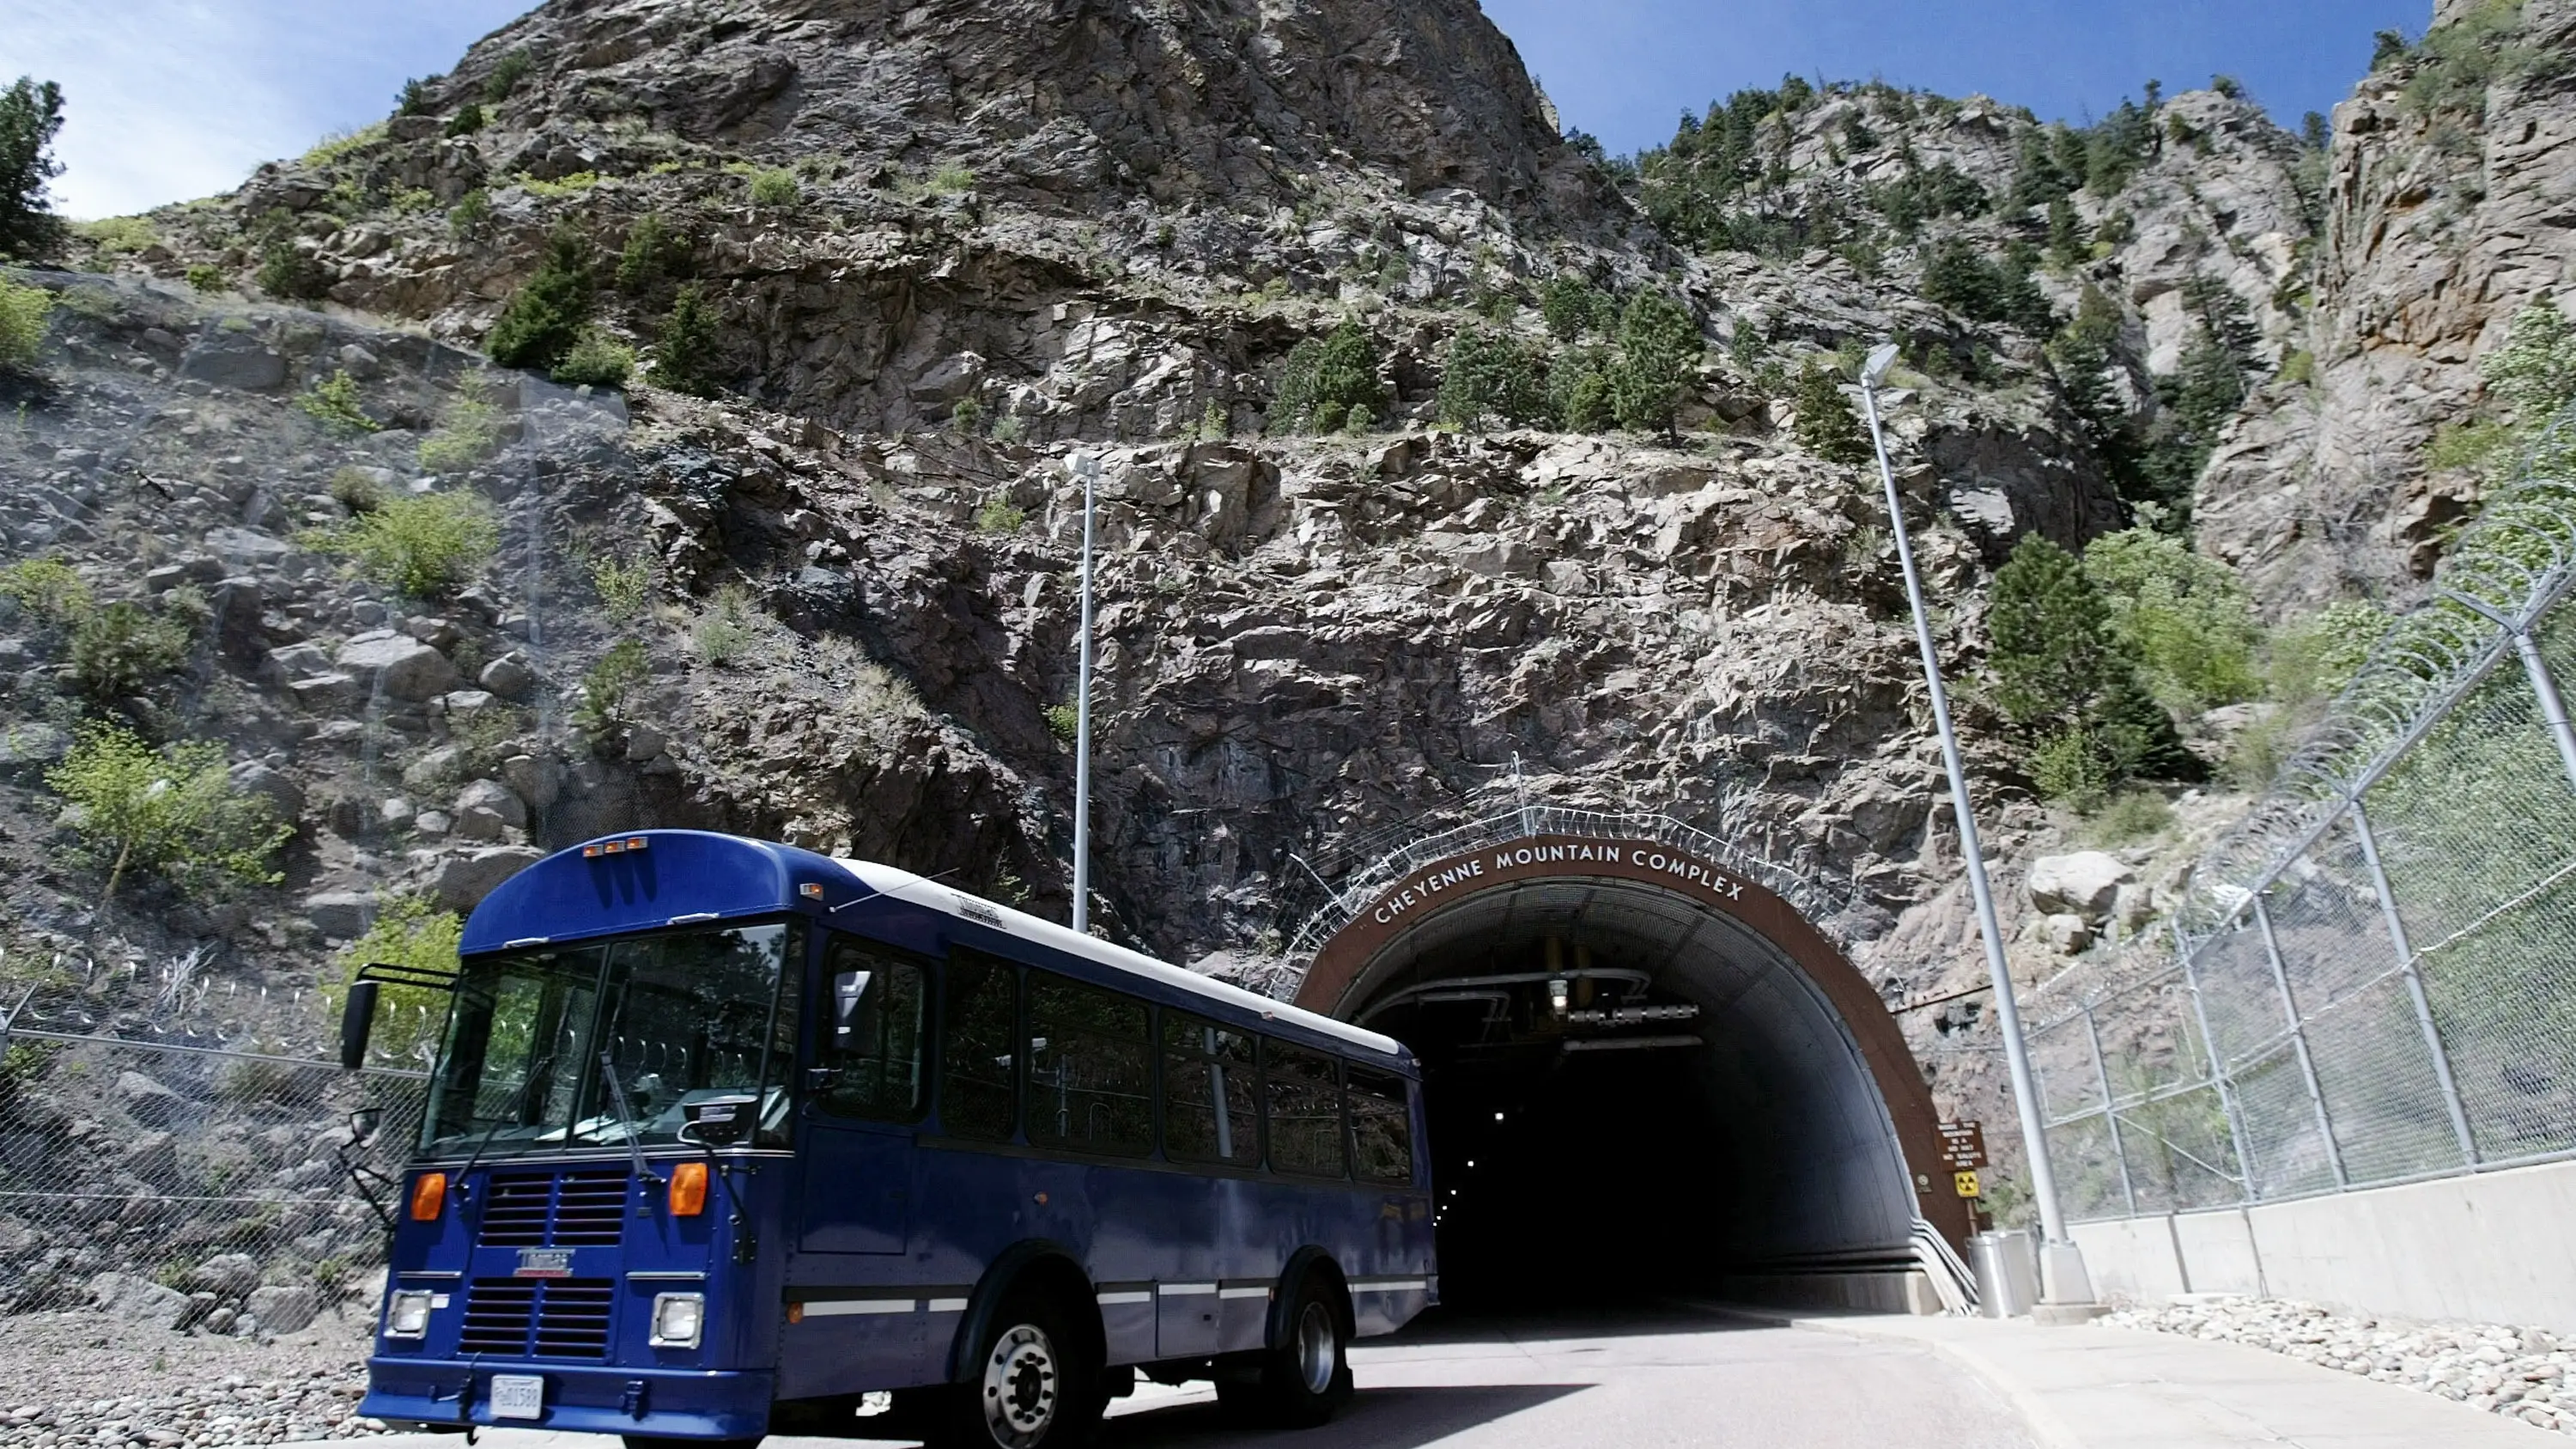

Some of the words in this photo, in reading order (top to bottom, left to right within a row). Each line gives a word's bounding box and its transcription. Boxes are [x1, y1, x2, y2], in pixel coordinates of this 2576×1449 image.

[1375, 859, 1484, 924] CHEYENNE
[1497, 844, 1620, 869] MOUNTAIN
[1632, 849, 1745, 902] COMPLEX
